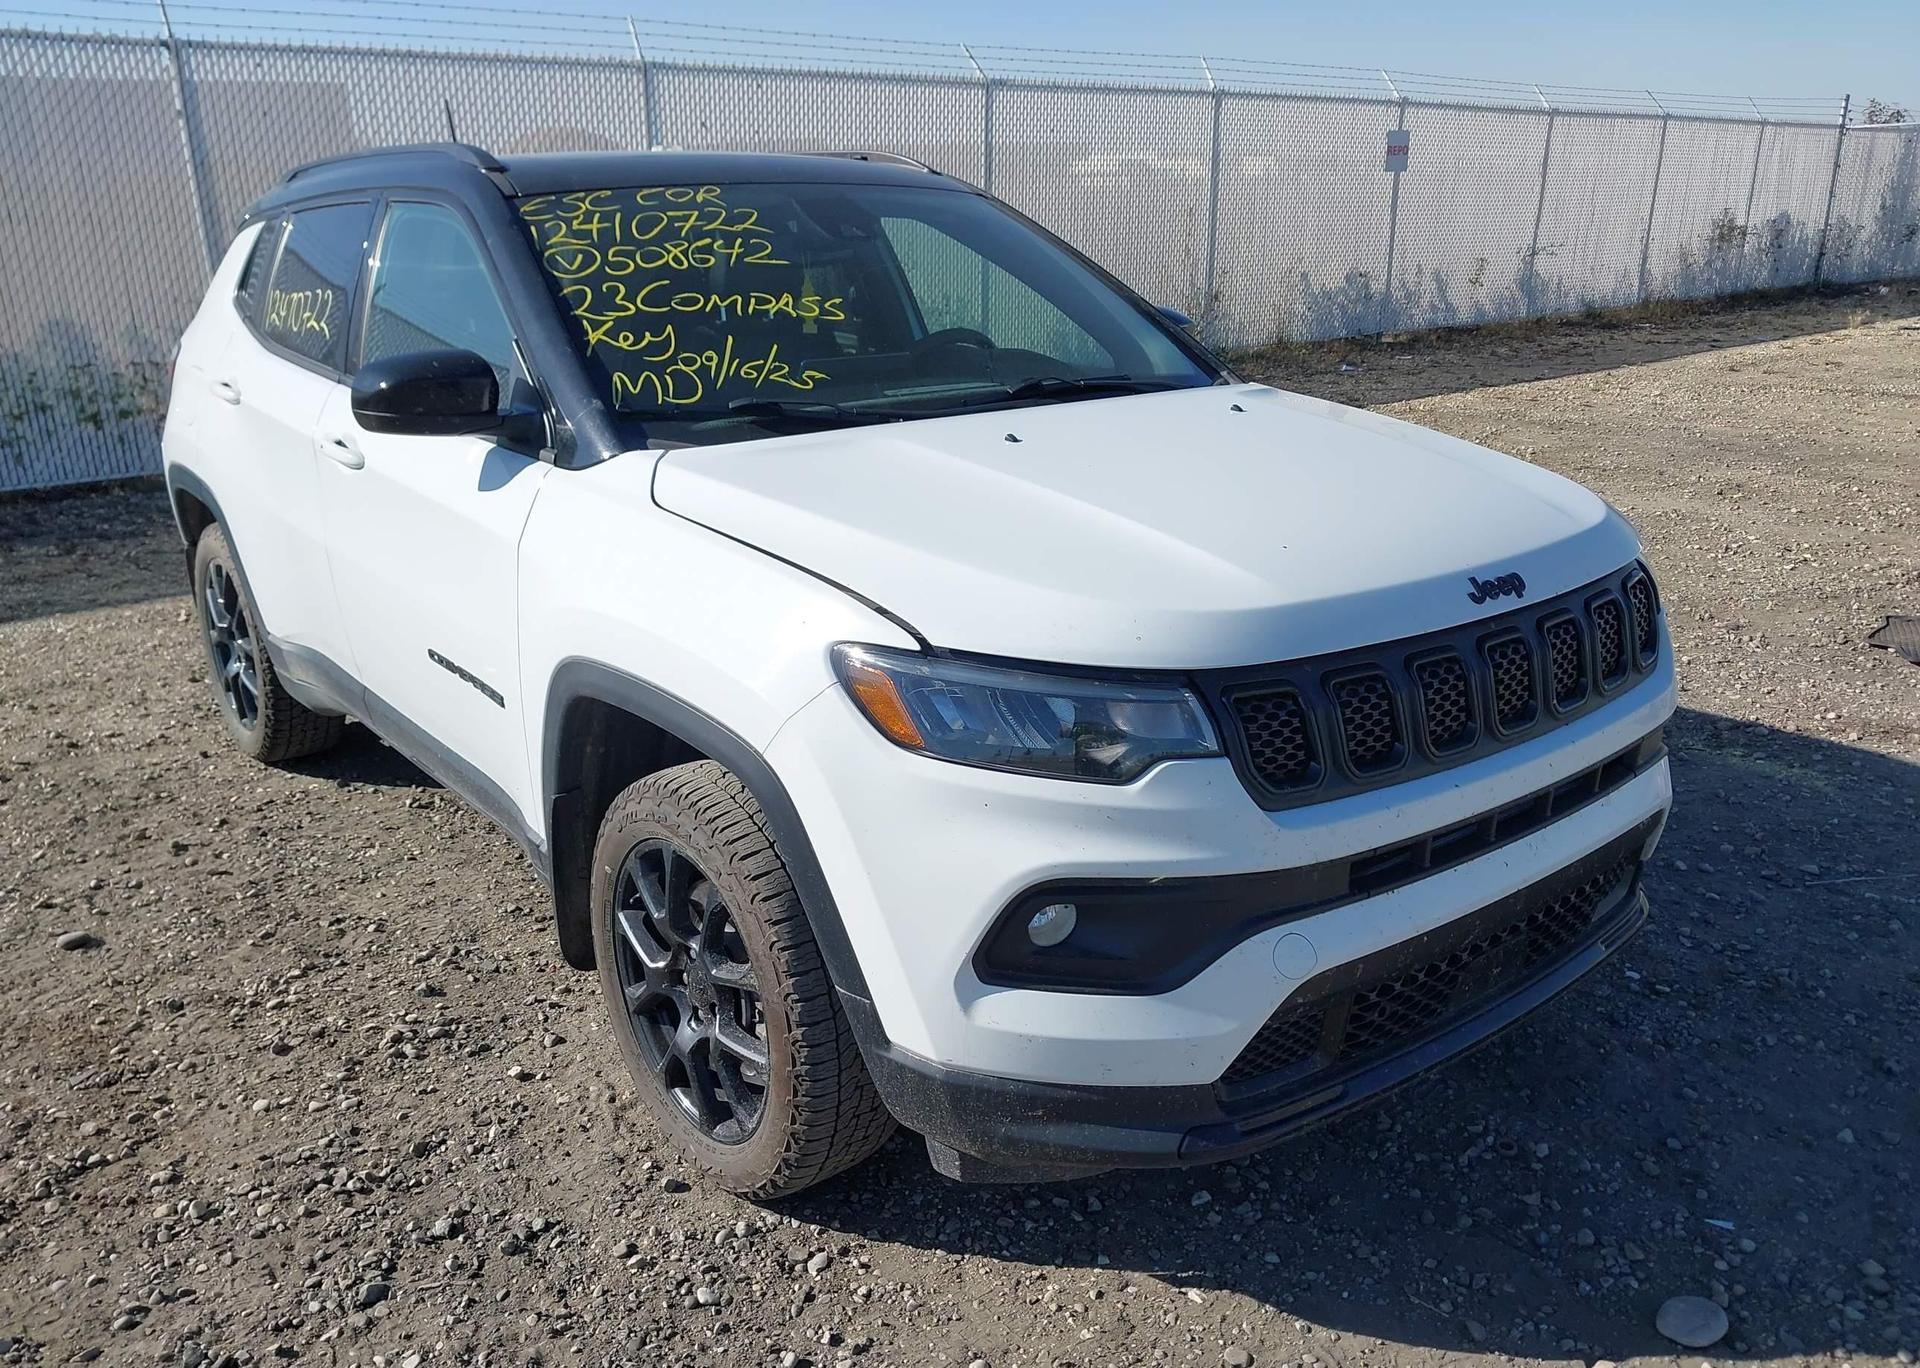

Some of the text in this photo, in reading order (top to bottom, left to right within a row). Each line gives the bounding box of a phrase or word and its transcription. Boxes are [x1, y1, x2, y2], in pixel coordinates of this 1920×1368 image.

[1387, 145, 1409, 155] REPO
[636, 186, 727, 206] COR
[530, 208, 774, 251] 12410722
[1466, 572, 1527, 606] Jeep
